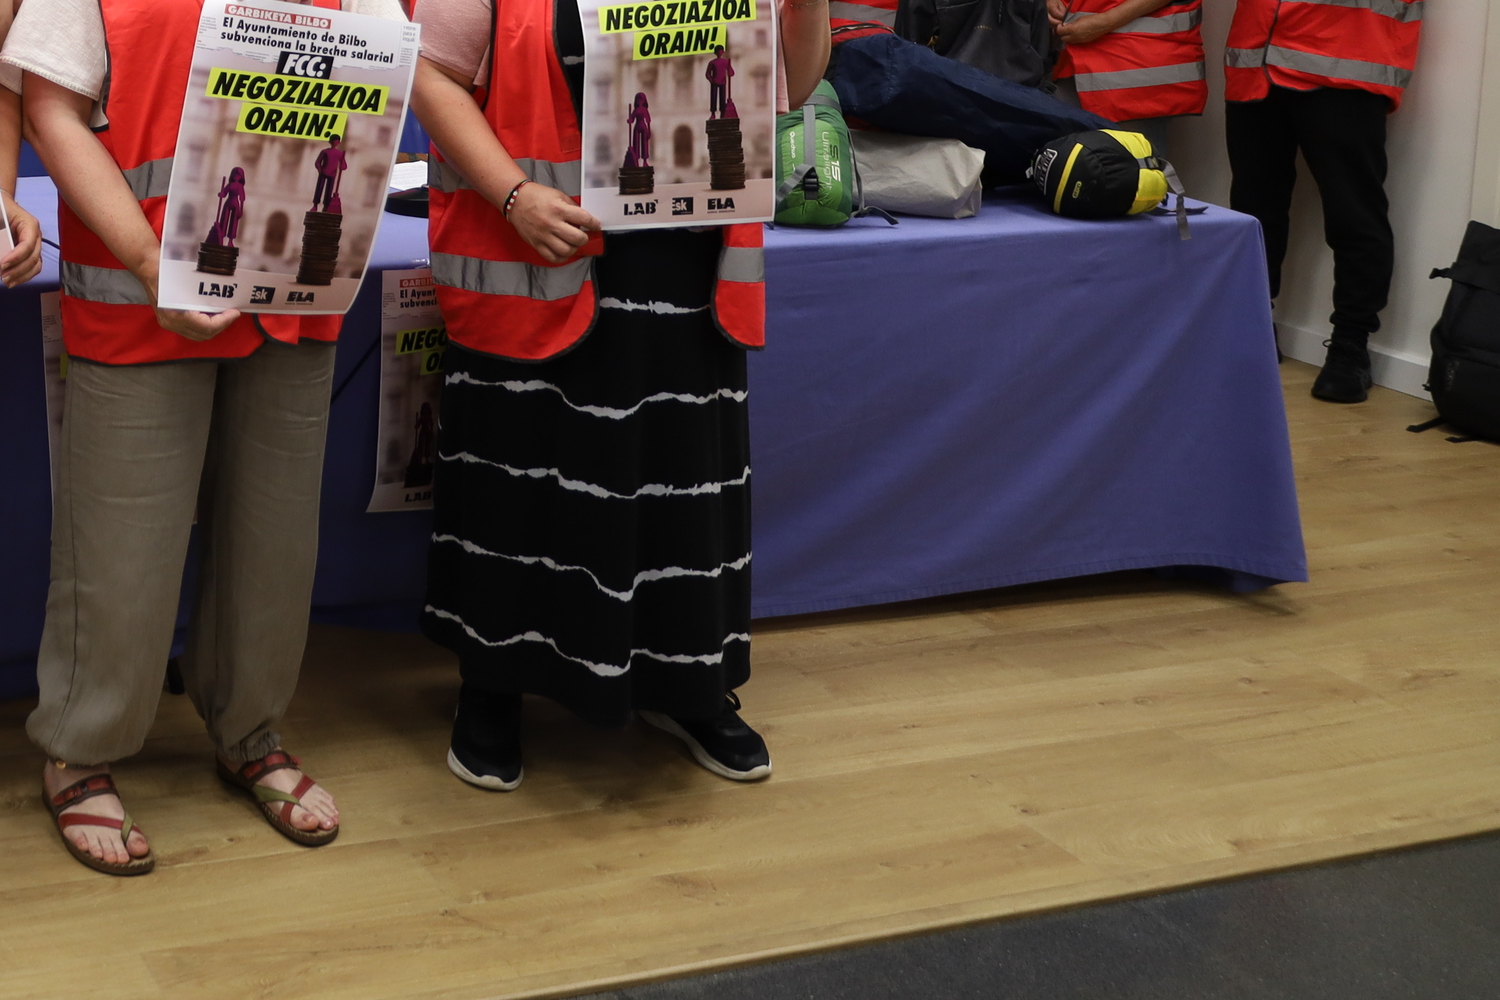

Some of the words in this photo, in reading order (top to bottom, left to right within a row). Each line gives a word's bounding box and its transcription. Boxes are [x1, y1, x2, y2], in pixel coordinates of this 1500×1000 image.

[228, 6, 292, 23] GARBIKETA
[295, 16, 329, 28] BILBO
[223, 17, 233, 28] El
[237, 20, 317, 40] Ayuntamiento
[321, 31, 335, 43] de
[339, 34, 367, 48] Bilbo
[639, 27, 718, 57] ORAIN!
[221, 31, 292, 49] subvenciona
[296, 39, 306, 51] la
[310, 41, 347, 57] brecha
[351, 47, 394, 64] salarial
[282, 53, 327, 77] FCC:
[212, 71, 382, 113] NEGOZIAZIOA
[244, 106, 339, 138] ORAIN!
[830, 144, 841, 182] S15
[624, 200, 658, 216] LAB
[707, 198, 735, 210] ELA
[198, 282, 238, 299] LAB
[286, 291, 315, 302] ELA
[400, 289, 408, 298] El
[400, 298, 437, 308] subvenci
